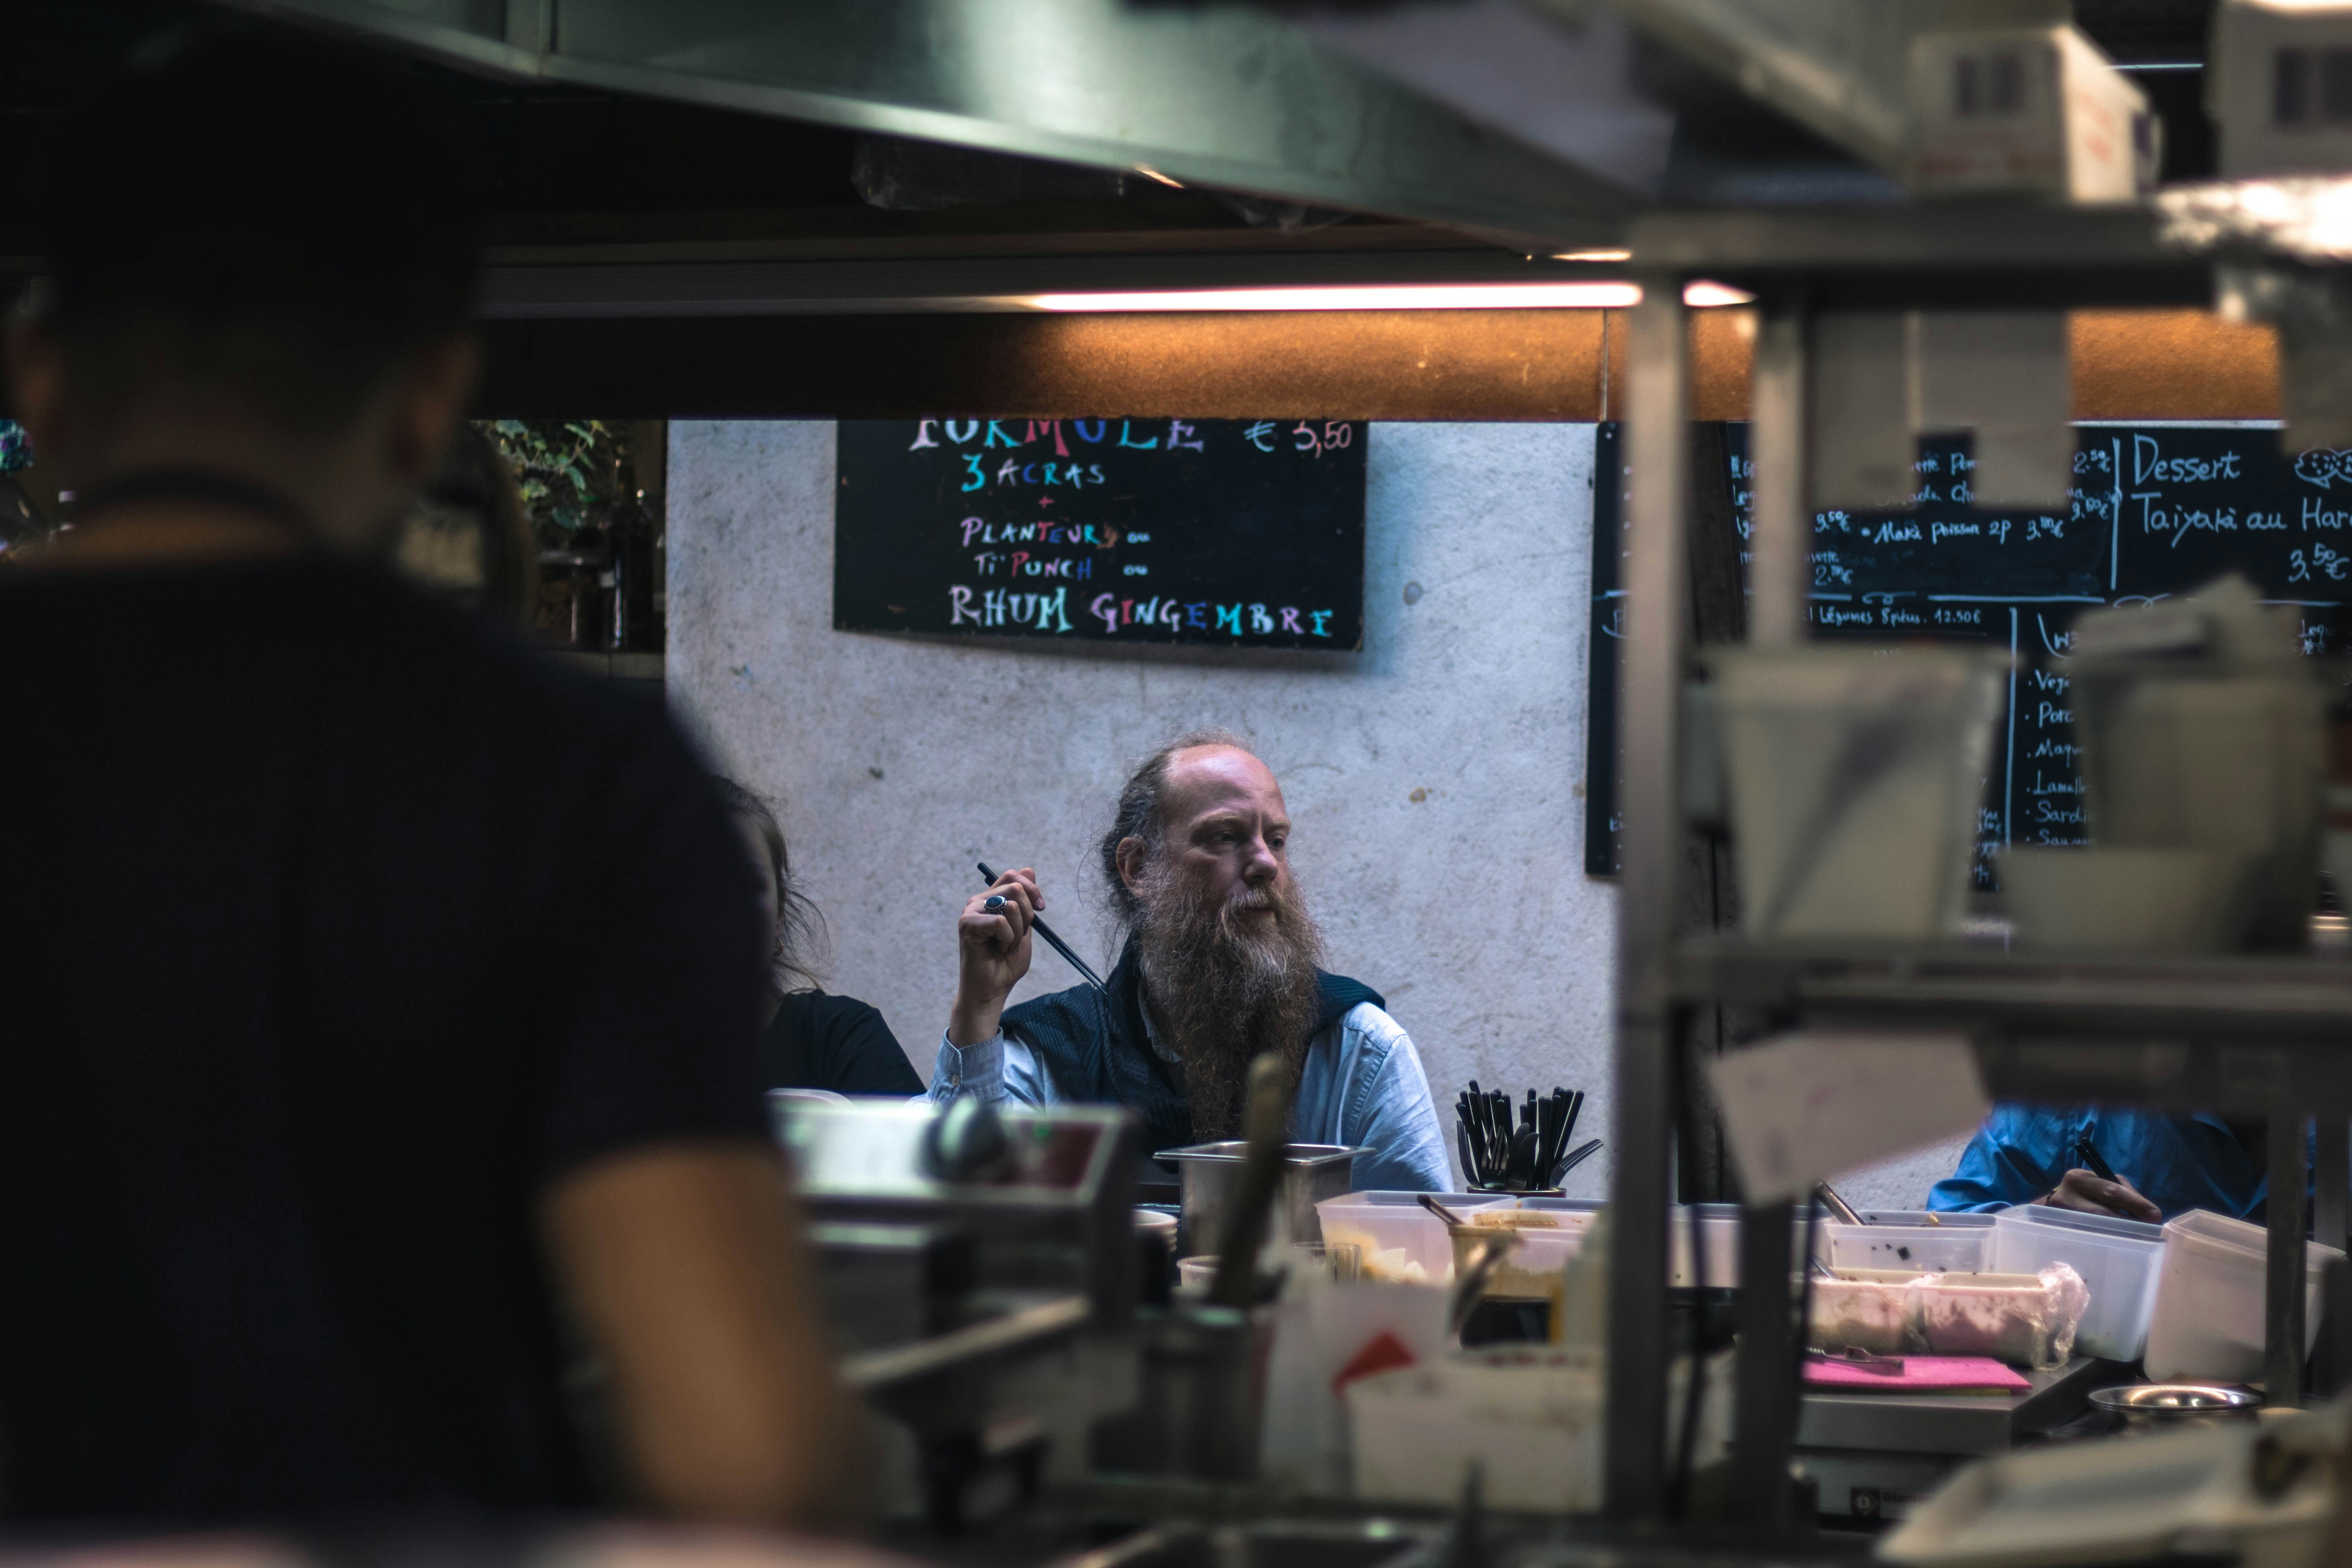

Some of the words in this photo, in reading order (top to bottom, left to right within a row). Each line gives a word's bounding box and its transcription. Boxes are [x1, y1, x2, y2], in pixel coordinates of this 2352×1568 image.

[962, 454, 985, 492] 3
[997, 457, 1105, 489] ACRAS
[2134, 433, 2241, 486] Dessert
[2246, 512, 2288, 529] au
[2302, 496, 2352, 531] Har
[960, 516, 1102, 548] PLANTEUR
[1011, 551, 1092, 580] PUNCH
[949, 584, 1074, 633] RHUM
[1090, 591, 1334, 638] GINGEMBRE
[2034, 799, 2089, 824] Sardi
